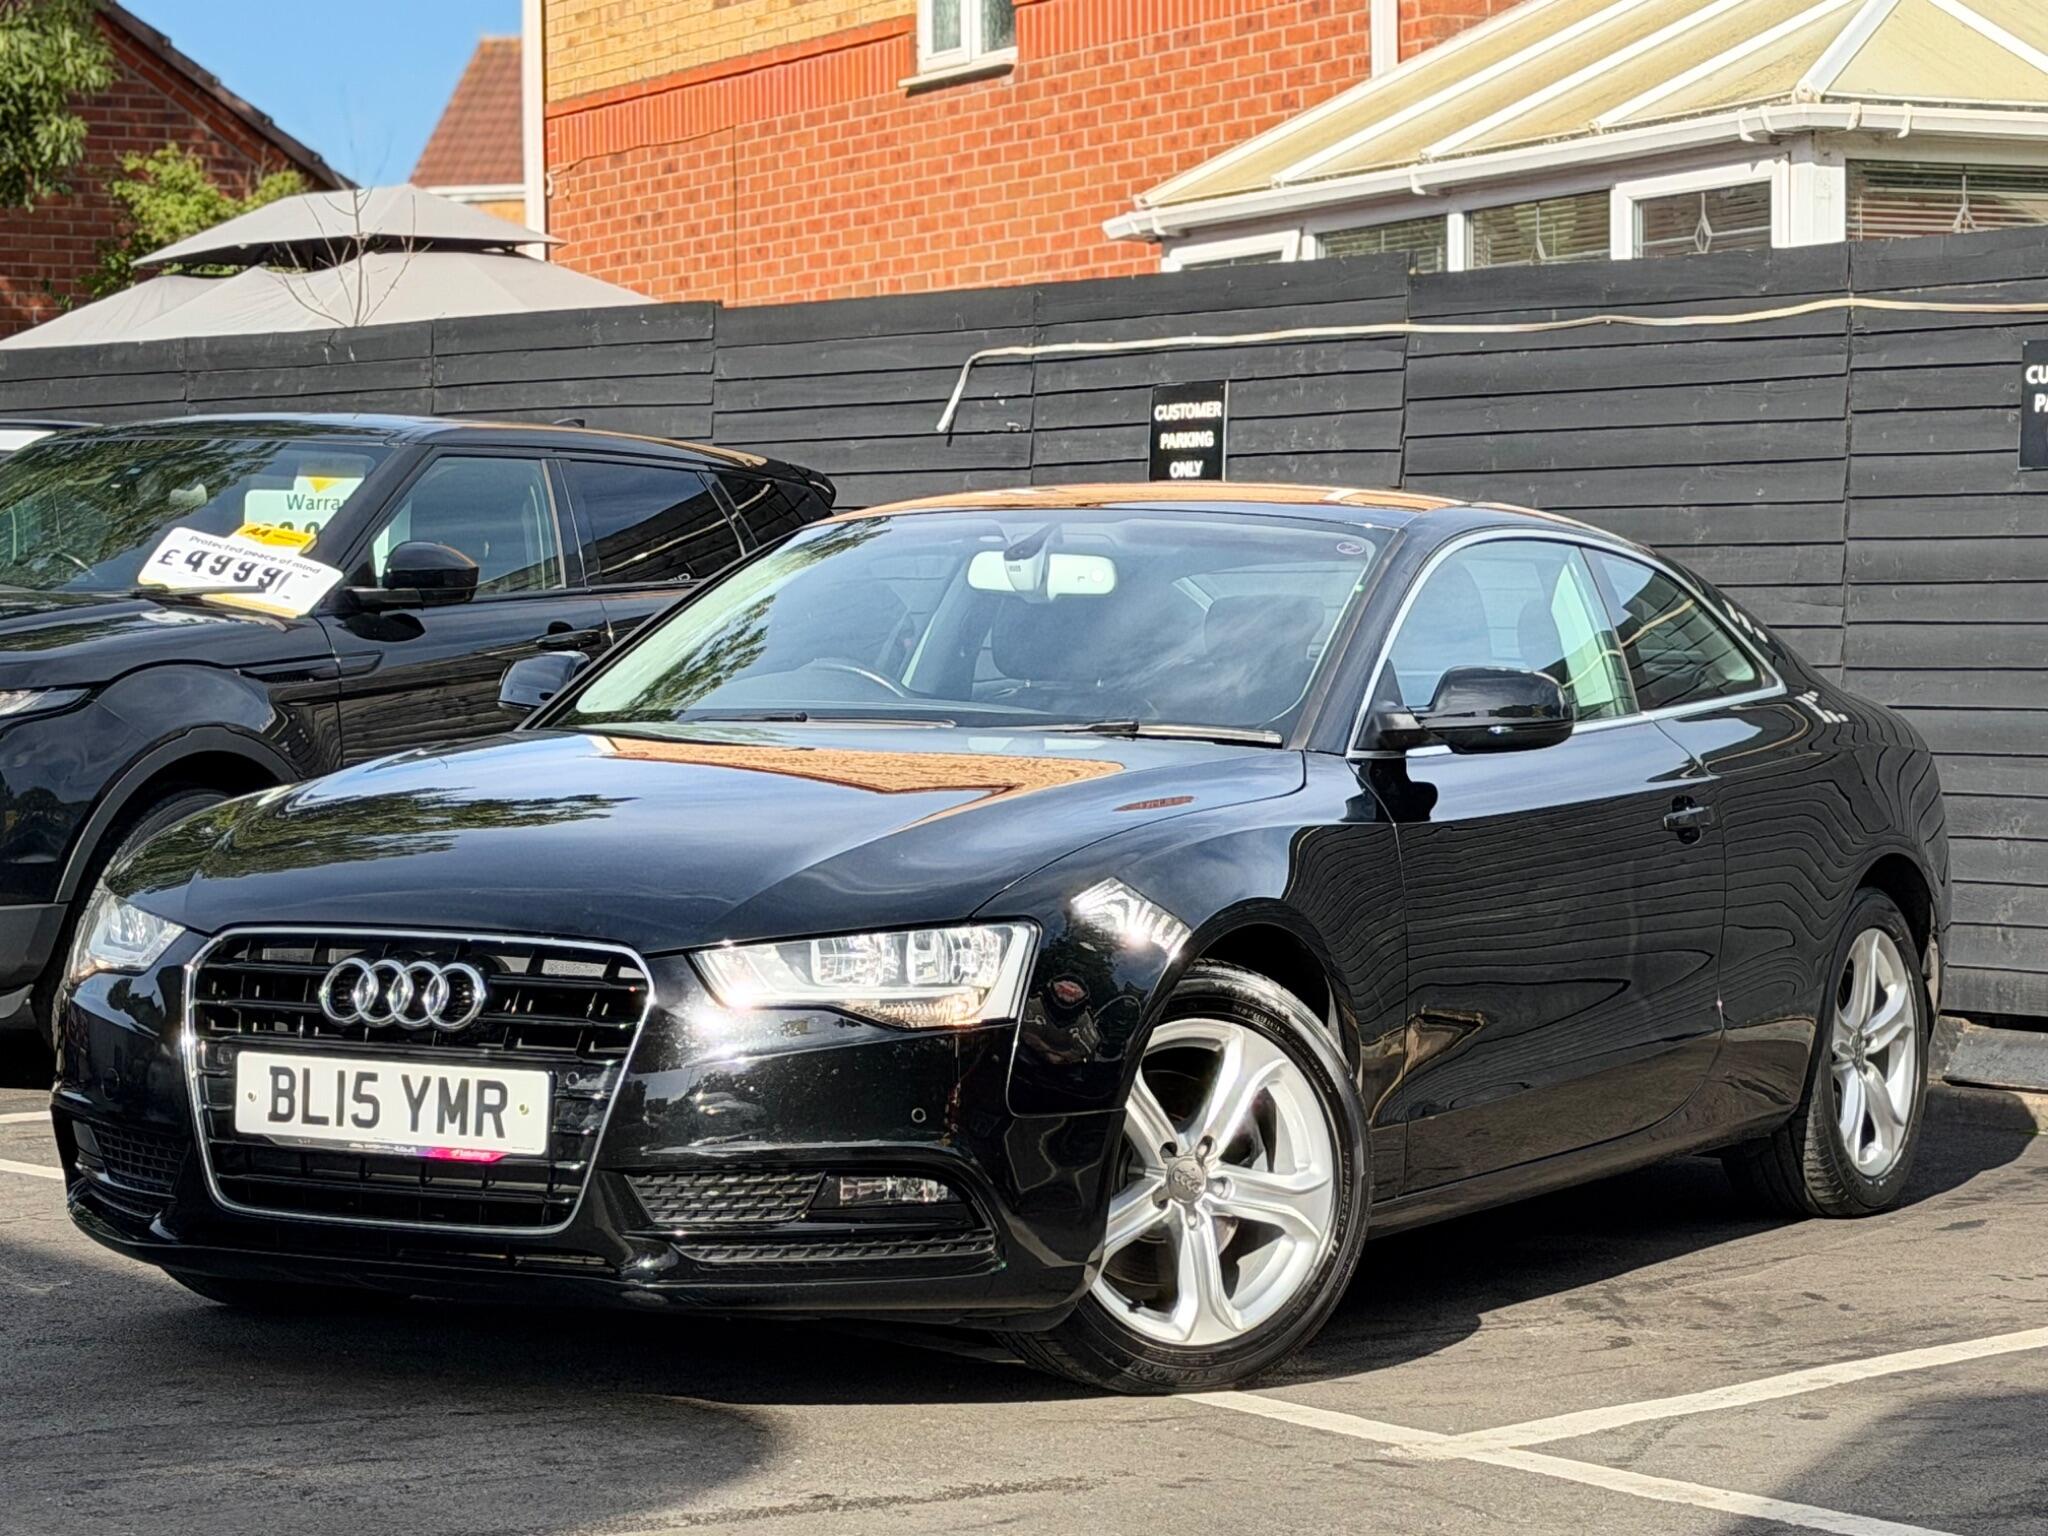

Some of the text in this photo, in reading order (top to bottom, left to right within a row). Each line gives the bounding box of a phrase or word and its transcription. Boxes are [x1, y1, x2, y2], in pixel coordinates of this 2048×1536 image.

[1154, 401, 1222, 421] CUSTOMER
[1159, 430, 1214, 450] PARKING
[1169, 460, 1203, 479] ONLY
[286, 494, 345, 511] Warra
[189, 535, 323, 574] Protected peace of mind
[267, 1065, 509, 1140] BL15 YMR
